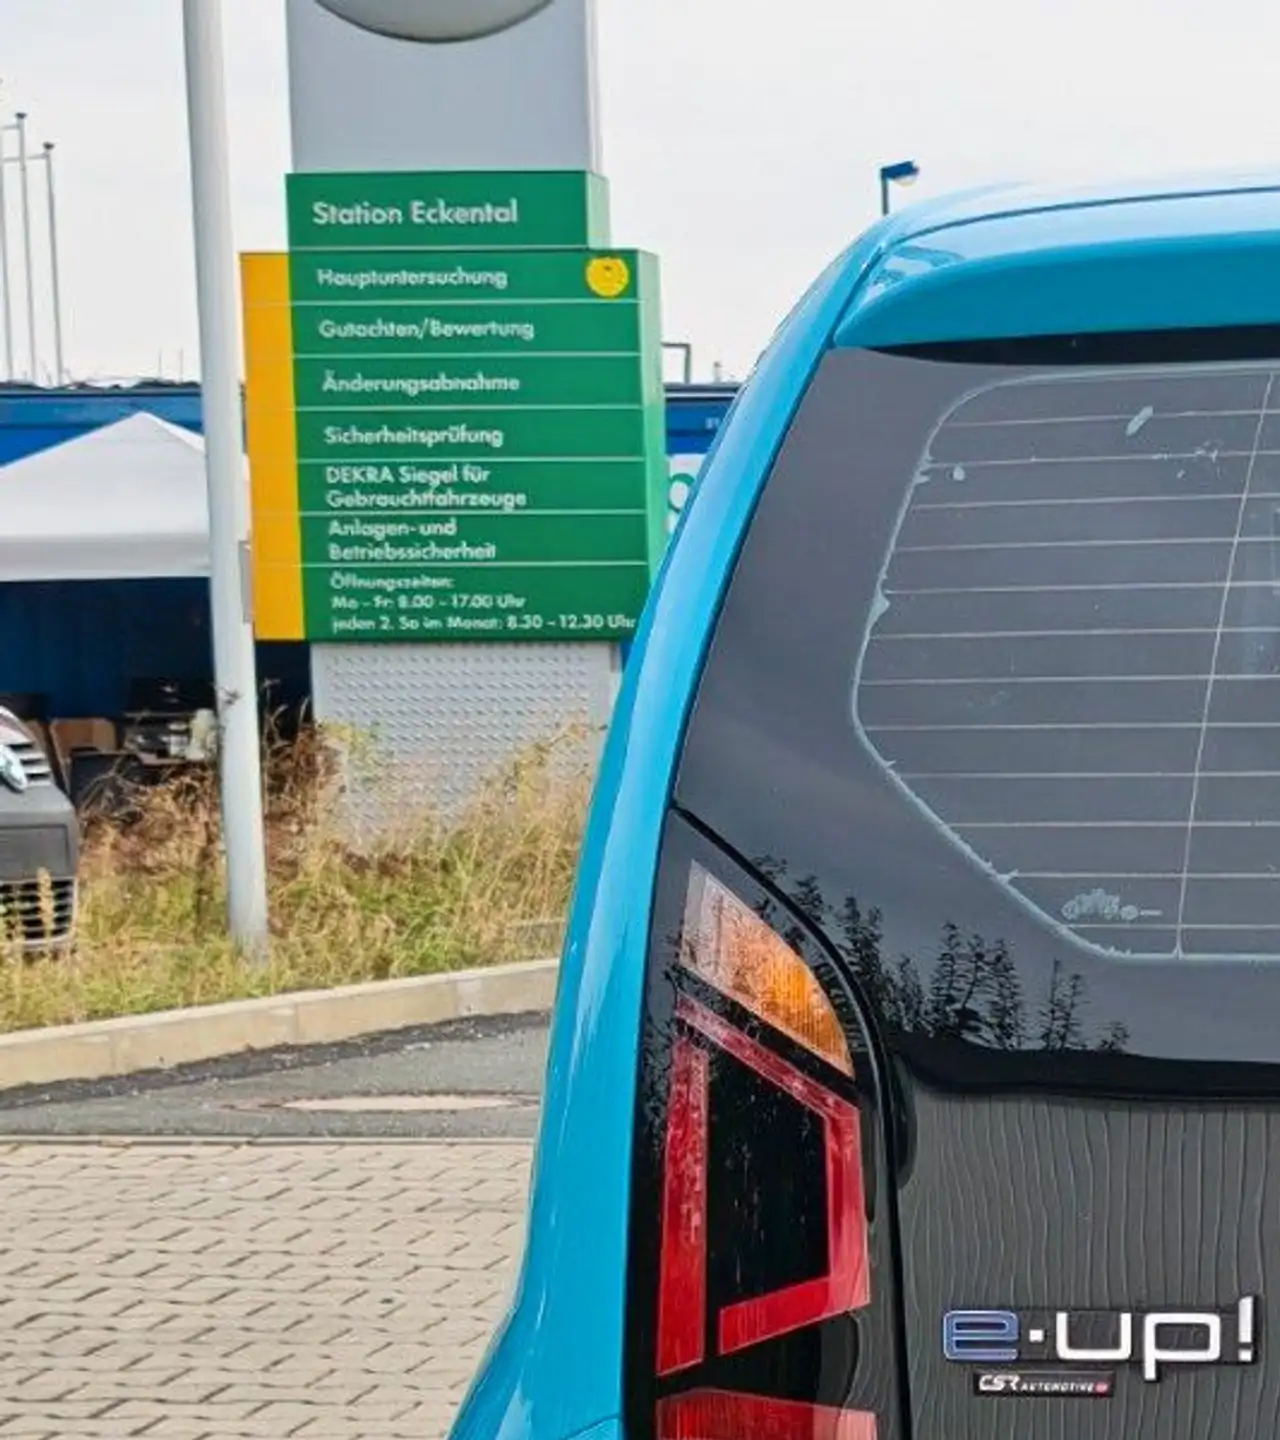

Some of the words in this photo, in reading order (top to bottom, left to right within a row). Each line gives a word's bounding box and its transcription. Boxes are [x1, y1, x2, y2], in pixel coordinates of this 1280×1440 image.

[312, 201, 403, 225] Station
[410, 198, 518, 224] Eckental
[316, 266, 508, 290] Hauptuntersuchung
[318, 318, 535, 341] Gutachten/Bewertung
[322, 369, 520, 396] Änderungsabnahme
[324, 424, 504, 448] Sicherheitsprüfung
[326, 466, 394, 484] DEKRA
[399, 464, 458, 488] Siegel
[462, 464, 491, 483] für
[326, 488, 527, 514] Gebrauchtfahrzeuge
[328, 540, 497, 561] Betriebssicherheit
[331, 595, 359, 610] Mo
[451, 593, 493, 609] 17.00
[497, 593, 527, 609] Uhr
[333, 615, 376, 634] jeden
[422, 615, 443, 628] im
[558, 613, 604, 630] 12.30
[606, 613, 637, 629] Uhr
